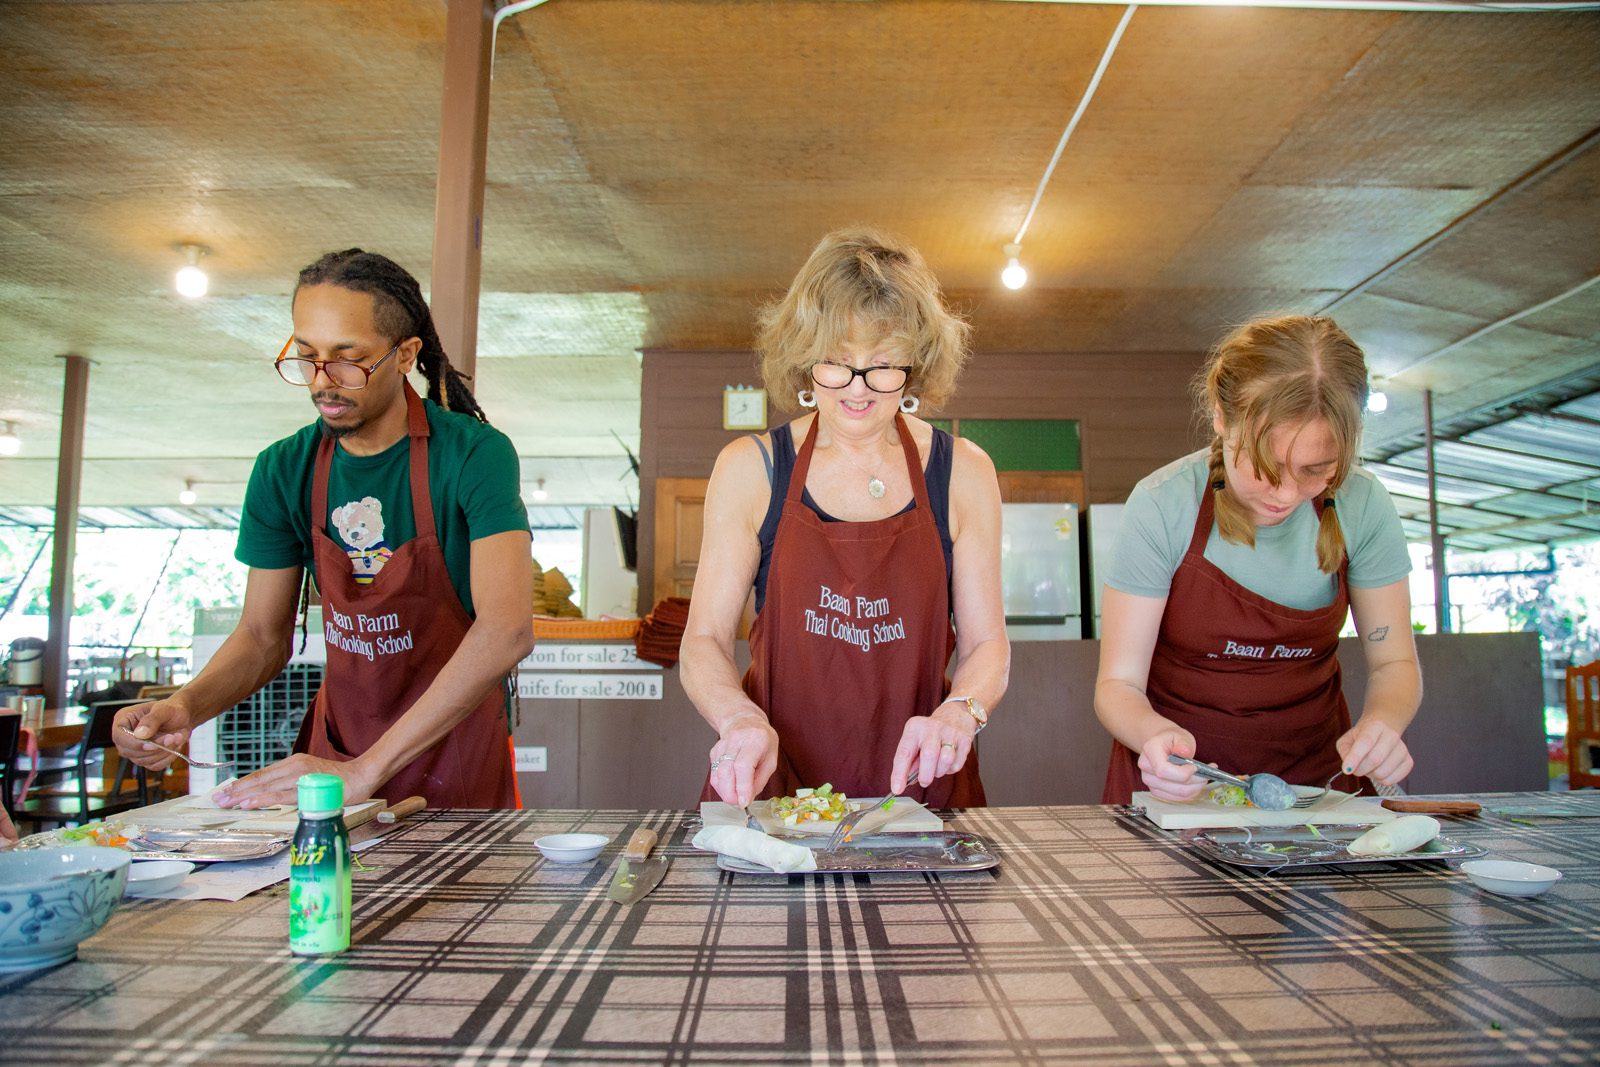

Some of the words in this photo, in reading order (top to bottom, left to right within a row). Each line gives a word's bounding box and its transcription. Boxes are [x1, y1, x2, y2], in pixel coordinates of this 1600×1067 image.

[819, 585, 851, 617] Baan
[856, 596, 890, 619] Farm
[356, 612, 400, 633] Farm
[805, 608, 829, 636] Thai
[831, 617, 871, 652] Cooking
[872, 616, 906, 644] School
[376, 629, 414, 655] School
[1223, 640, 1265, 658] Baan
[1269, 644, 1313, 658] Farm
[560, 647, 583, 663] for
[587, 647, 617, 664] sale
[554, 679, 578, 696] for
[581, 680, 612, 696] sale
[616, 681, 646, 697] 200
